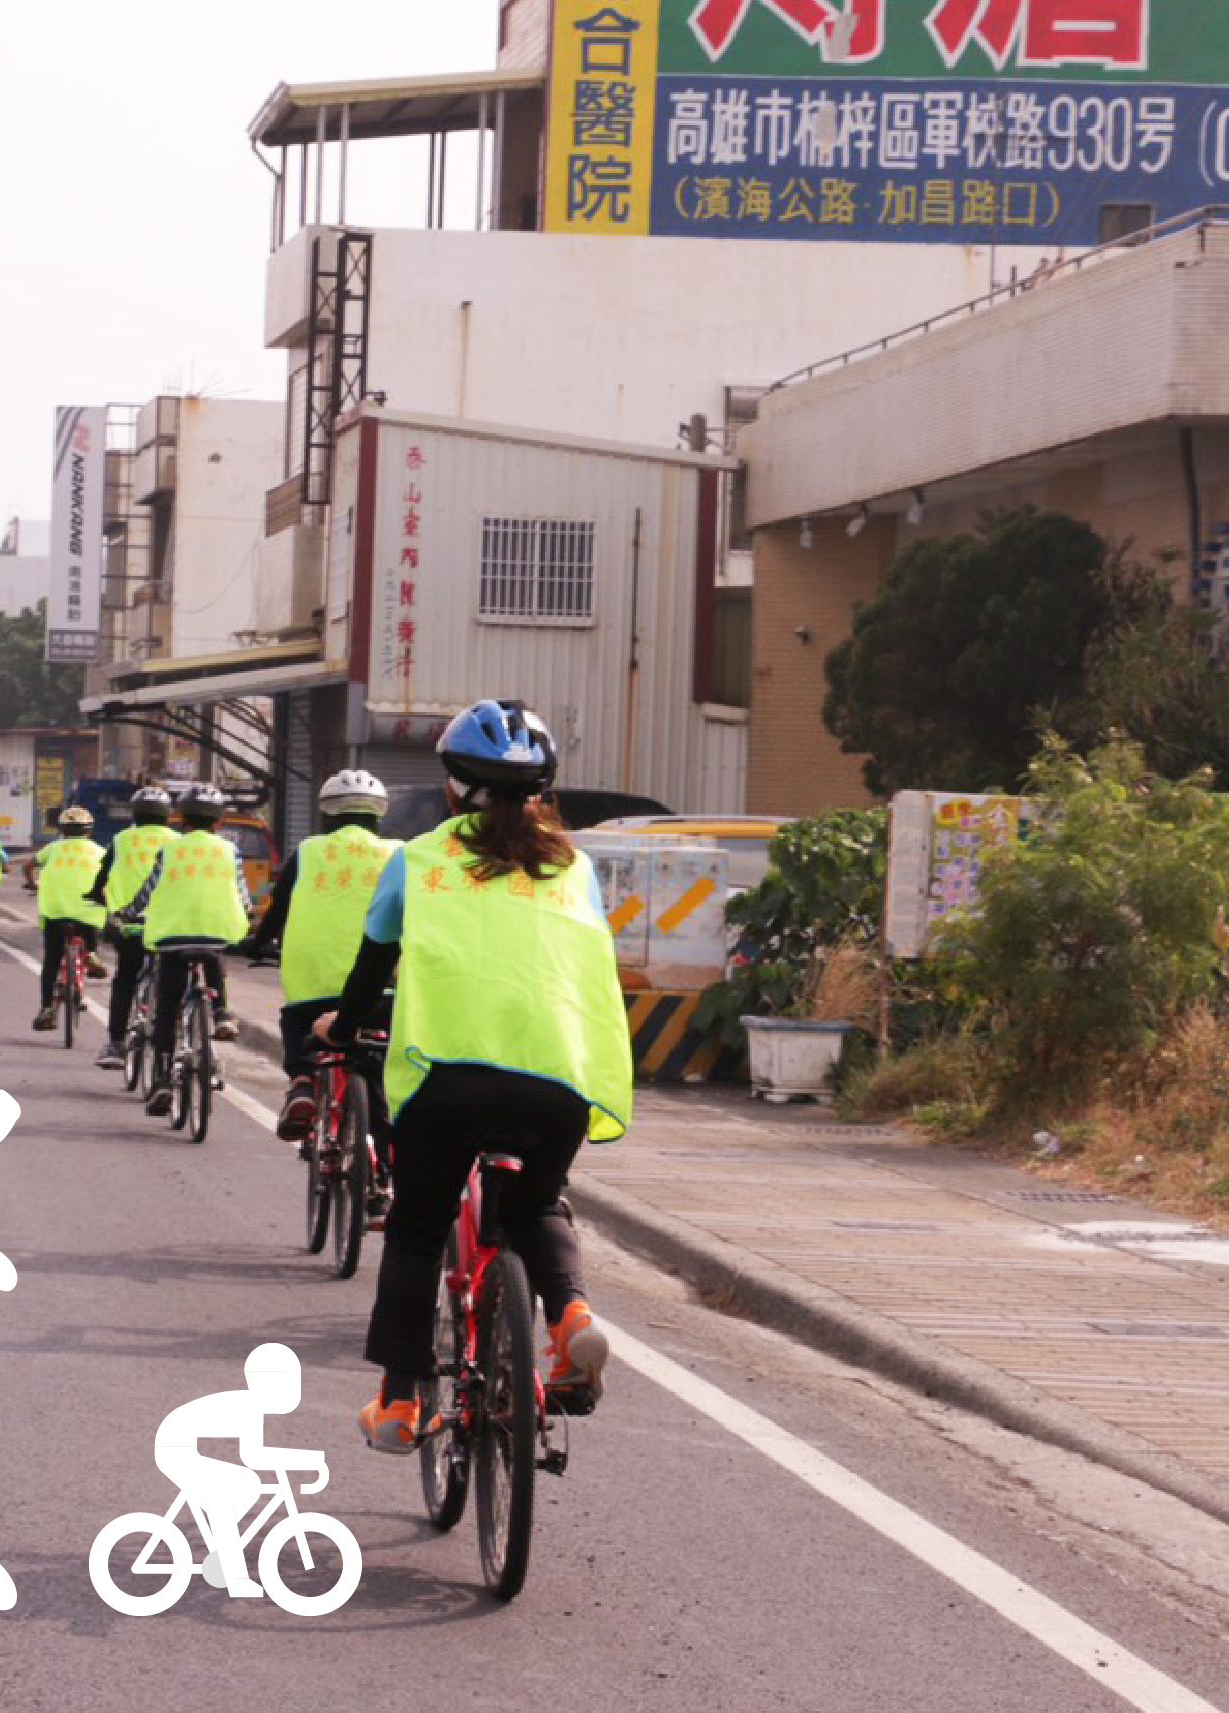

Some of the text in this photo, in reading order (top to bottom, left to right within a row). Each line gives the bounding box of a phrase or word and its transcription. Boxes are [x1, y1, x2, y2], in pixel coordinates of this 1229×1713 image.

[566, 8, 643, 223] 合醫院
[69, 453, 85, 558] NANKANG
